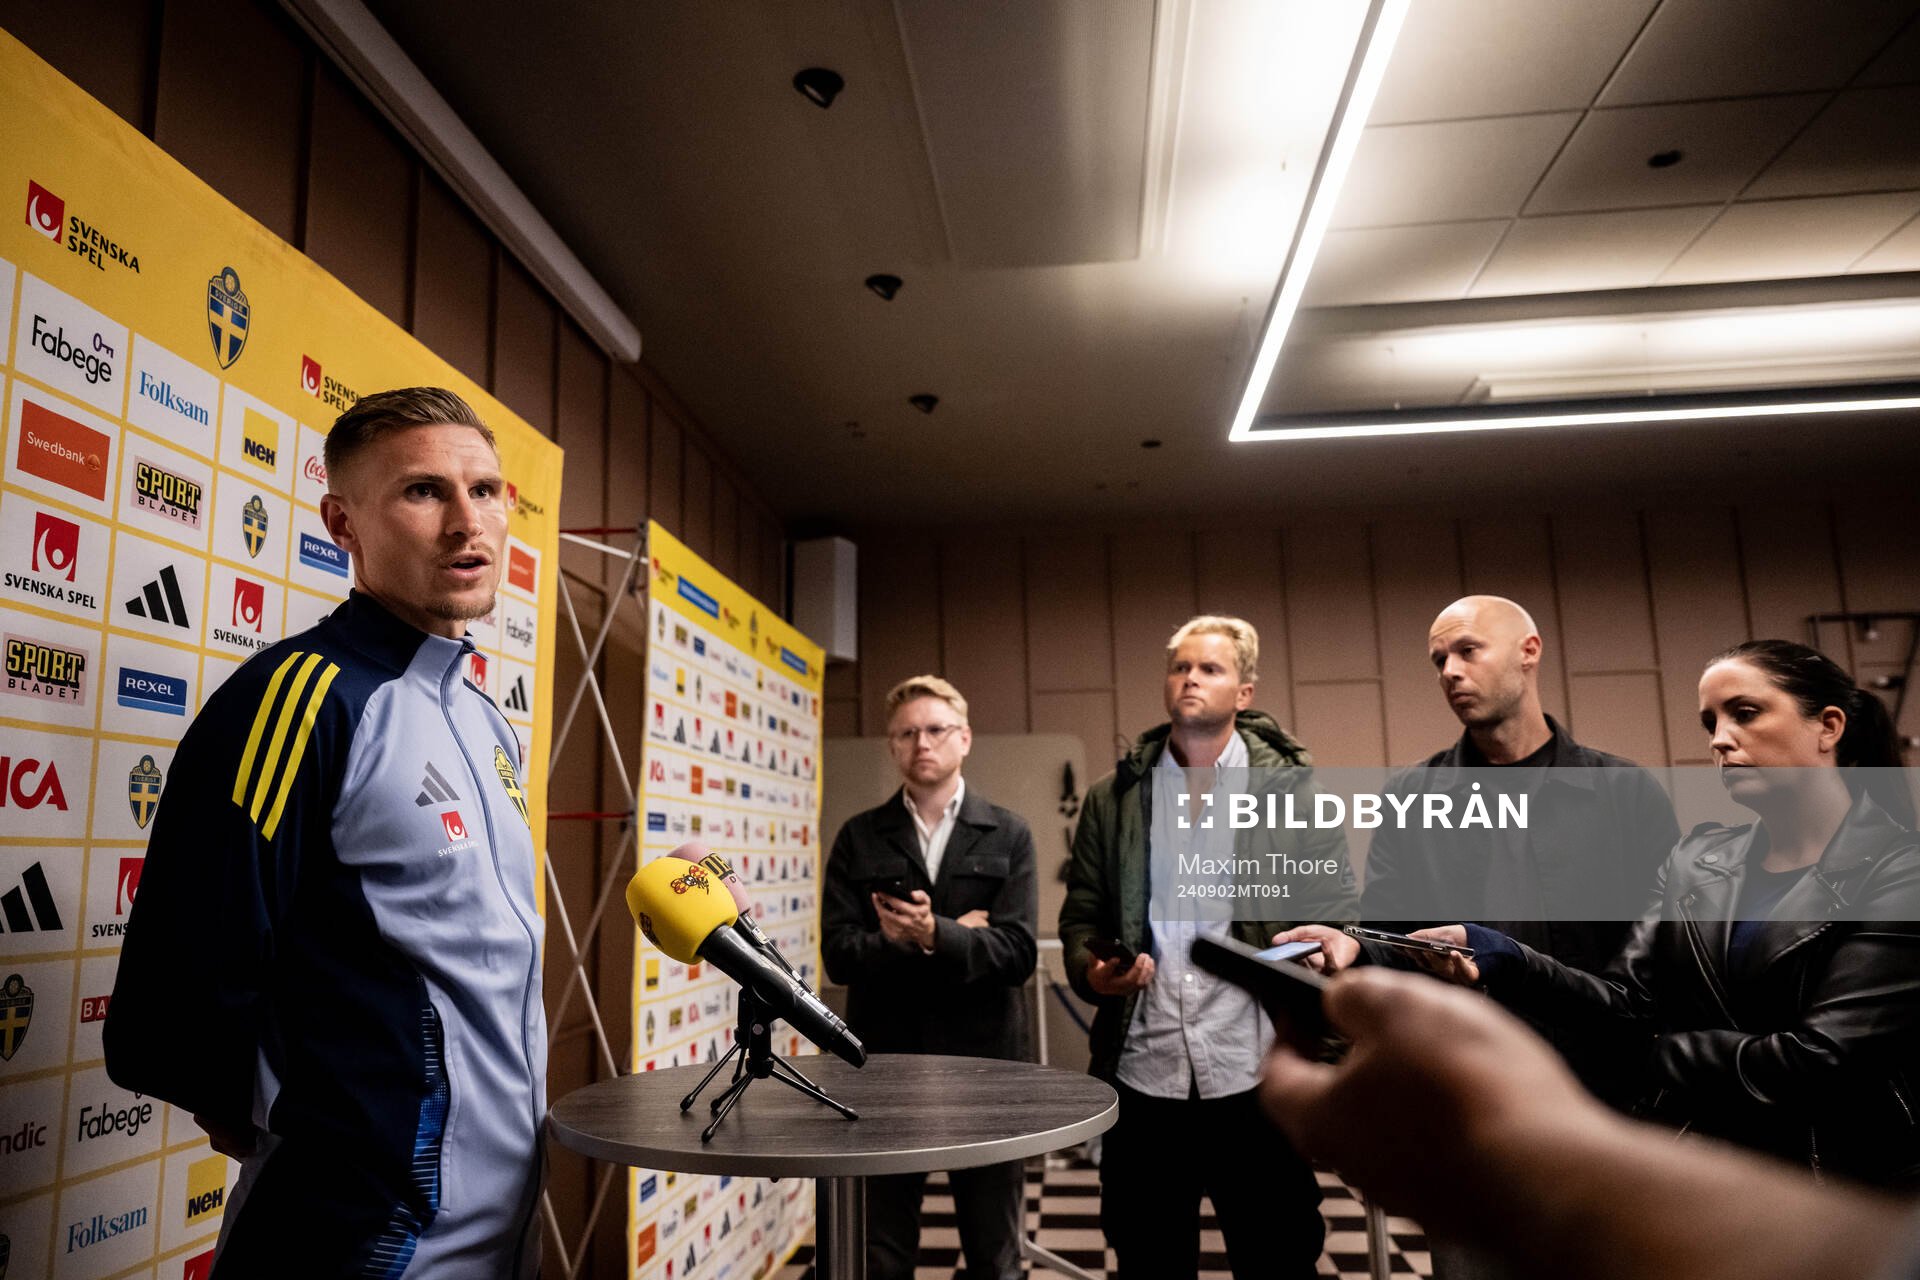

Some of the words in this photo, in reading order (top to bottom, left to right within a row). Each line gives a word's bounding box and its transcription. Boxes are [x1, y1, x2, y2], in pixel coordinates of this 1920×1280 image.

[67, 234, 105, 272] SPEL
[70, 215, 141, 274] SVENSKA
[31, 314, 113, 384] Fabege
[138, 370, 209, 427] Folksam
[324, 375, 360, 403] SVENS
[27, 431, 86, 465] Swedbank
[136, 462, 202, 516] SPORT
[138, 495, 197, 525] BLADET
[5, 572, 64, 600] SVENSKA
[67, 589, 97, 609] SPEL
[213, 628, 254, 649] SVENSKA
[6, 639, 86, 690] SPORT
[8, 678, 80, 700] BLADET
[0, 756, 69, 811] ICA
[92, 923, 129, 938] SVENS
[78, 1103, 152, 1142] Fabege
[67, 1206, 148, 1254] Folksam
